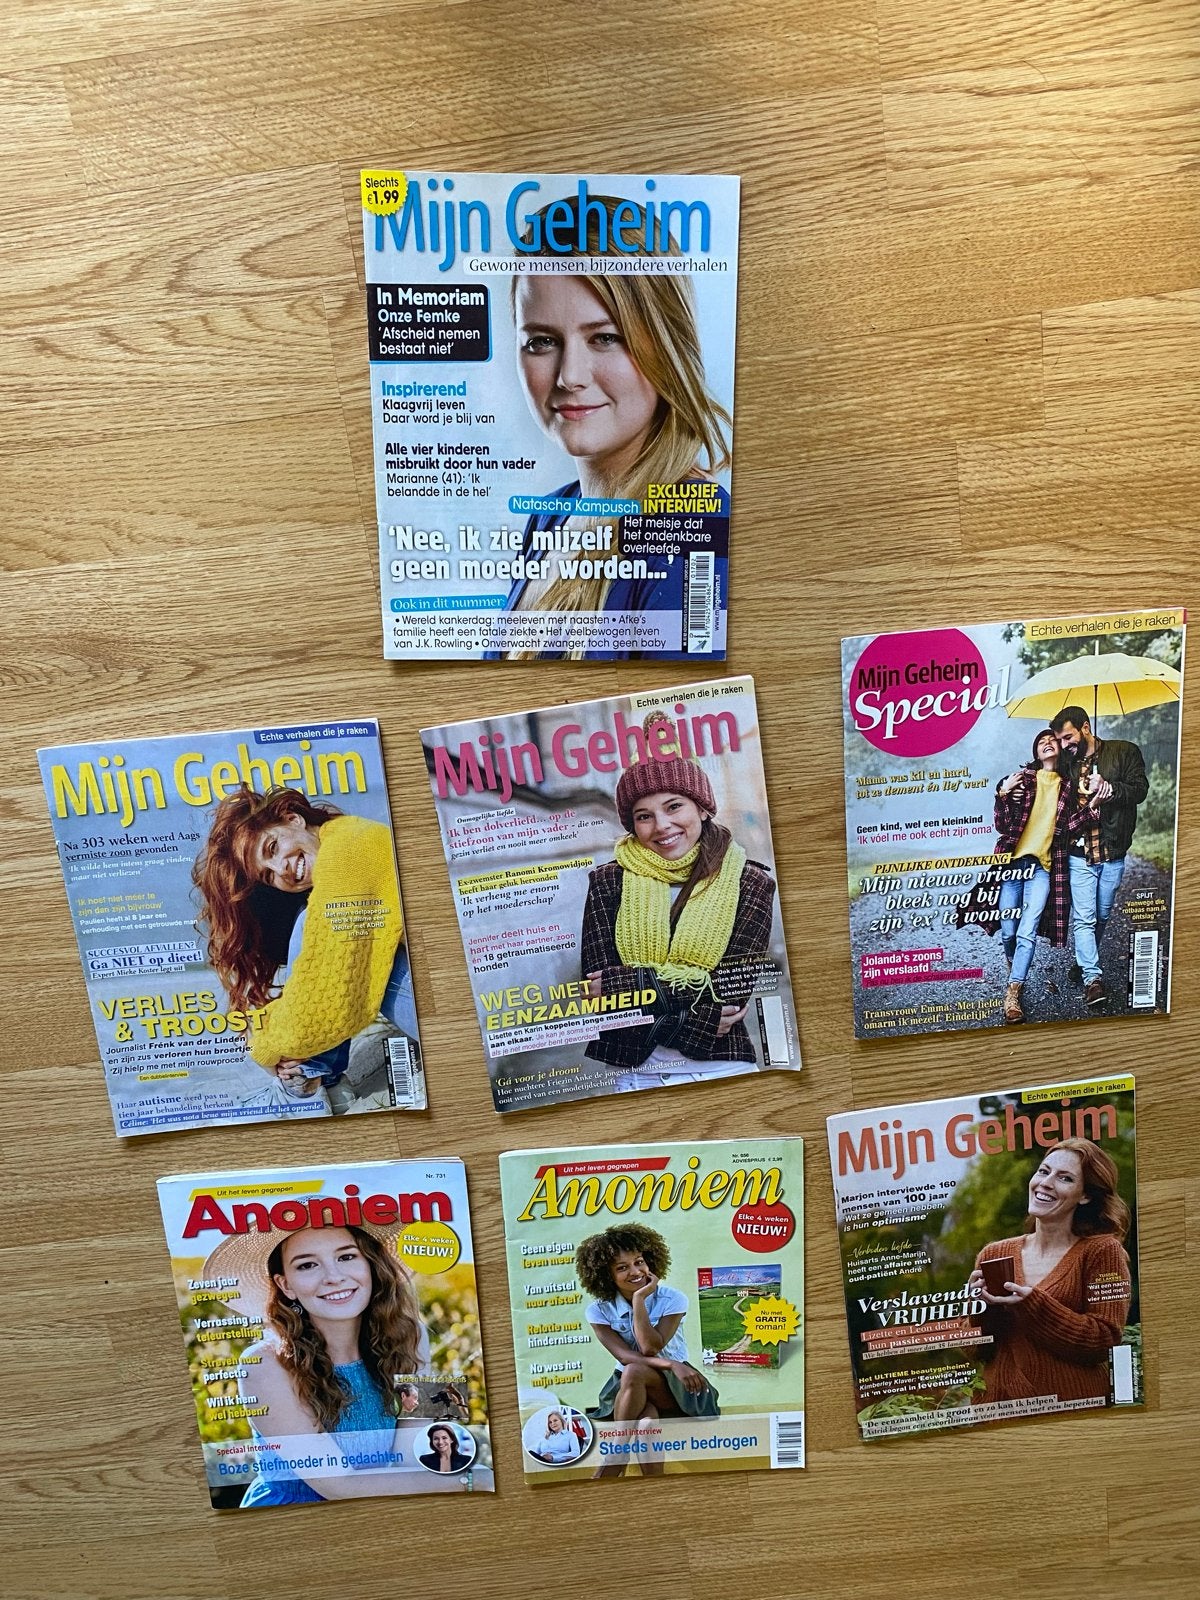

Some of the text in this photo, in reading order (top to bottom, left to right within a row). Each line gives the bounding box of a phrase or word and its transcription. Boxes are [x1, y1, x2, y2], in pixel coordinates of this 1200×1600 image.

[366, 178, 399, 188] Slechts
[368, 190, 399, 205] €1,99
[374, 179, 711, 271] Mijn Geheim
[469, 258, 728, 275] Gewone mensen, bijzondere verhalen
[377, 288, 484, 306] In Memoriam
[378, 310, 460, 323] Onze Femke
[439, 328, 480, 340] nemen
[379, 341, 425, 355] bestaat
[382, 381, 466, 398] Inspirerend
[382, 400, 465, 412] Klaagvrij leven
[385, 443, 489, 455] Alle vier kinderen
[386, 458, 536, 469] misbruikt door hun vader
[648, 484, 718, 499] EXCLUSIEF
[512, 499, 639, 515] Natascha Kampusch
[643, 499, 722, 513] INTERVIEW!
[625, 517, 703, 530] Het meisje dat
[459, 526, 482, 550] ik
[490, 526, 523, 550] zie
[533, 526, 613, 553] mijzelf
[624, 530, 711, 542] het ondenkbare
[623, 543, 680, 554] overleefde
[390, 559, 449, 582] geen
[459, 555, 550, 580] moeder
[394, 599, 417, 610] Ook
[419, 598, 430, 609] in
[433, 598, 449, 608] dit
[1031, 615, 1176, 636] Echte verhalen die je raken
[858, 659, 978, 689] Mijn Geheim
[637, 685, 744, 708] Echte verhalen die je raken
[855, 666, 1014, 739] Special
[260, 727, 368, 742] Echte verhalen die je raken
[433, 704, 741, 803] Mijn Geheim
[51, 740, 368, 827] Mijn Geheim
[64, 832, 200, 851] Na 303 weken werd Aags
[505, 868, 535, 878] Ranomi
[538, 859, 593, 873] Kromowidjojo
[874, 854, 1008, 874] PIJNLIJKE ONTDEKKING
[908, 871, 972, 888] nieuwe
[977, 864, 1036, 882] vriend
[886, 887, 1001, 910] bleek nog bij
[870, 915, 903, 933] zijn
[943, 911, 959, 925] te
[90, 952, 201, 970] Ga NIET op dieet!
[864, 951, 942, 966] Jolanda's zoons
[864, 963, 929, 979] zijn verslaafd
[480, 980, 592, 1012] WEG MET
[98, 991, 217, 1021] VERLIES
[486, 989, 657, 1031] EENZAAMHEID
[115, 1009, 267, 1042] & TROOST
[106, 1043, 146, 1055] Journalist
[149, 1041, 175, 1050] Frénk
[196, 1038, 212, 1046] der
[215, 1036, 245, 1045] Linden
[1027, 1082, 1126, 1101] Echte verhalen die je raken
[838, 1098, 1117, 1180] Mijn Geheim
[262, 1186, 293, 1194] gegrepen
[517, 1156, 784, 1220] Anoniem
[841, 1192, 874, 1203] Marjon
[877, 1184, 936, 1197] interviewde
[182, 1184, 453, 1238] Anoniem
[842, 1193, 948, 1213] mensen van 100 jaar
[403, 1234, 419, 1242] Elke
[736, 1224, 787, 1236] NIEUW!
[402, 1244, 453, 1258] NIEUW!
[188, 1278, 238, 1289] Zeven jaar
[858, 1283, 982, 1314] Verslavende
[877, 1300, 987, 1327] VRIJHEID
[599, 1429, 627, 1438] Speciaal
[216, 1446, 245, 1457] Speciaal
[600, 1435, 757, 1456] Steeds weer bedrogen
[219, 1451, 403, 1475] Boze stiefmoeder in gedachten
